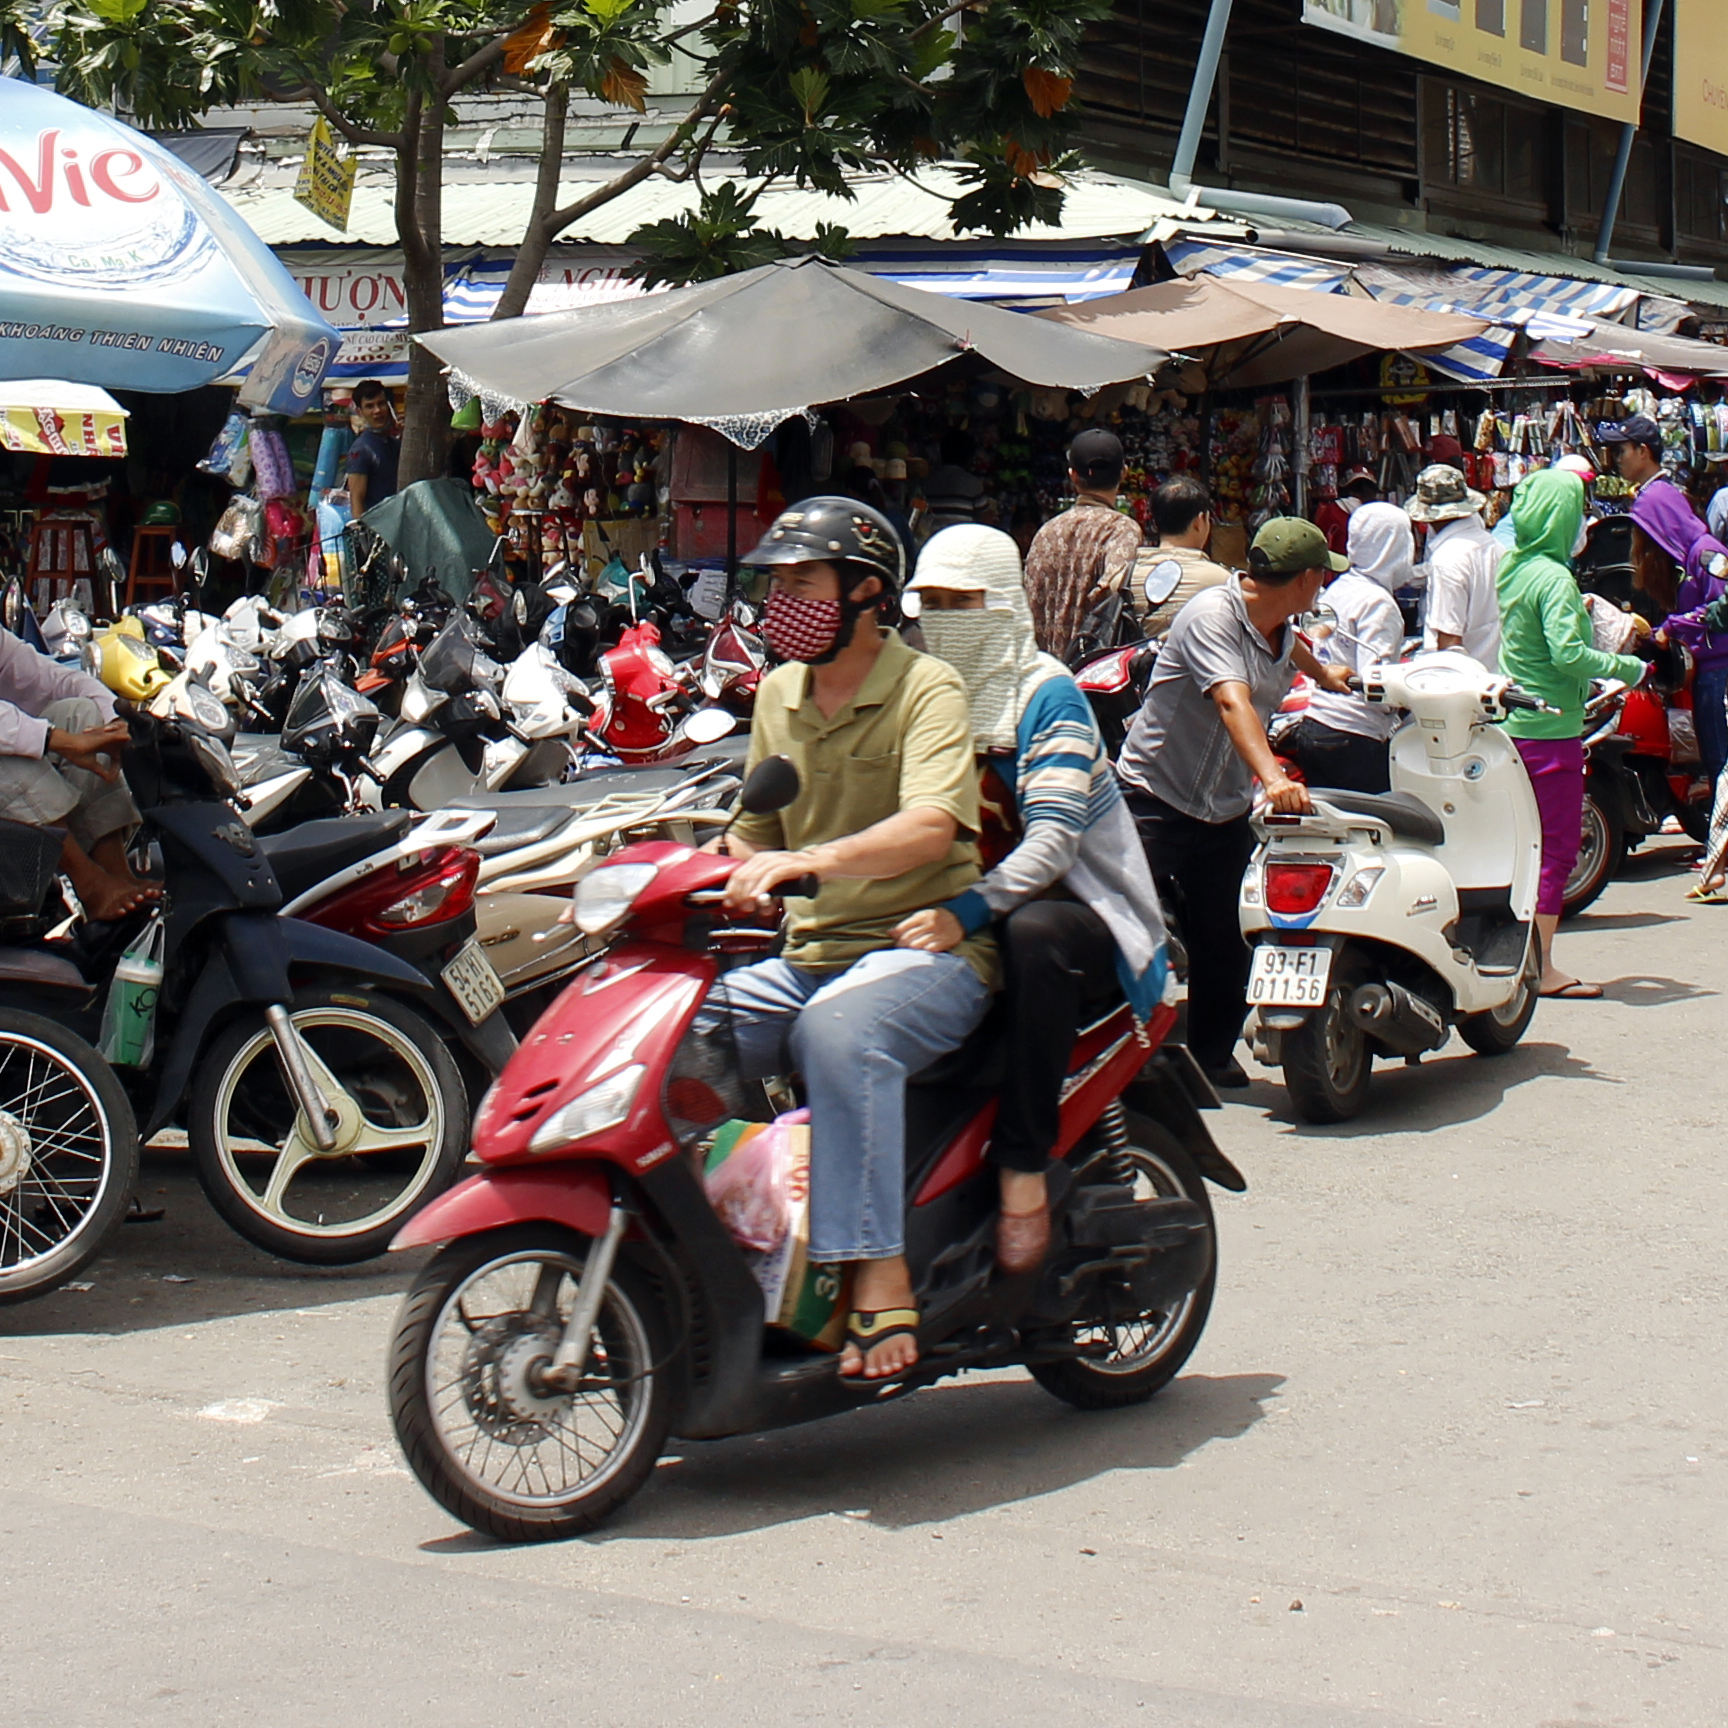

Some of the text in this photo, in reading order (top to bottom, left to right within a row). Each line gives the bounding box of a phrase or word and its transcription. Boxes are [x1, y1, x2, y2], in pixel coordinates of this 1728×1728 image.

[89, 327, 153, 352] THIÊN
[158, 336, 225, 363] NHIÊN
[1263, 949, 1318, 976] 93-F1
[464, 973, 500, 1017] 5163
[1251, 975, 1321, 1003] 011.56
